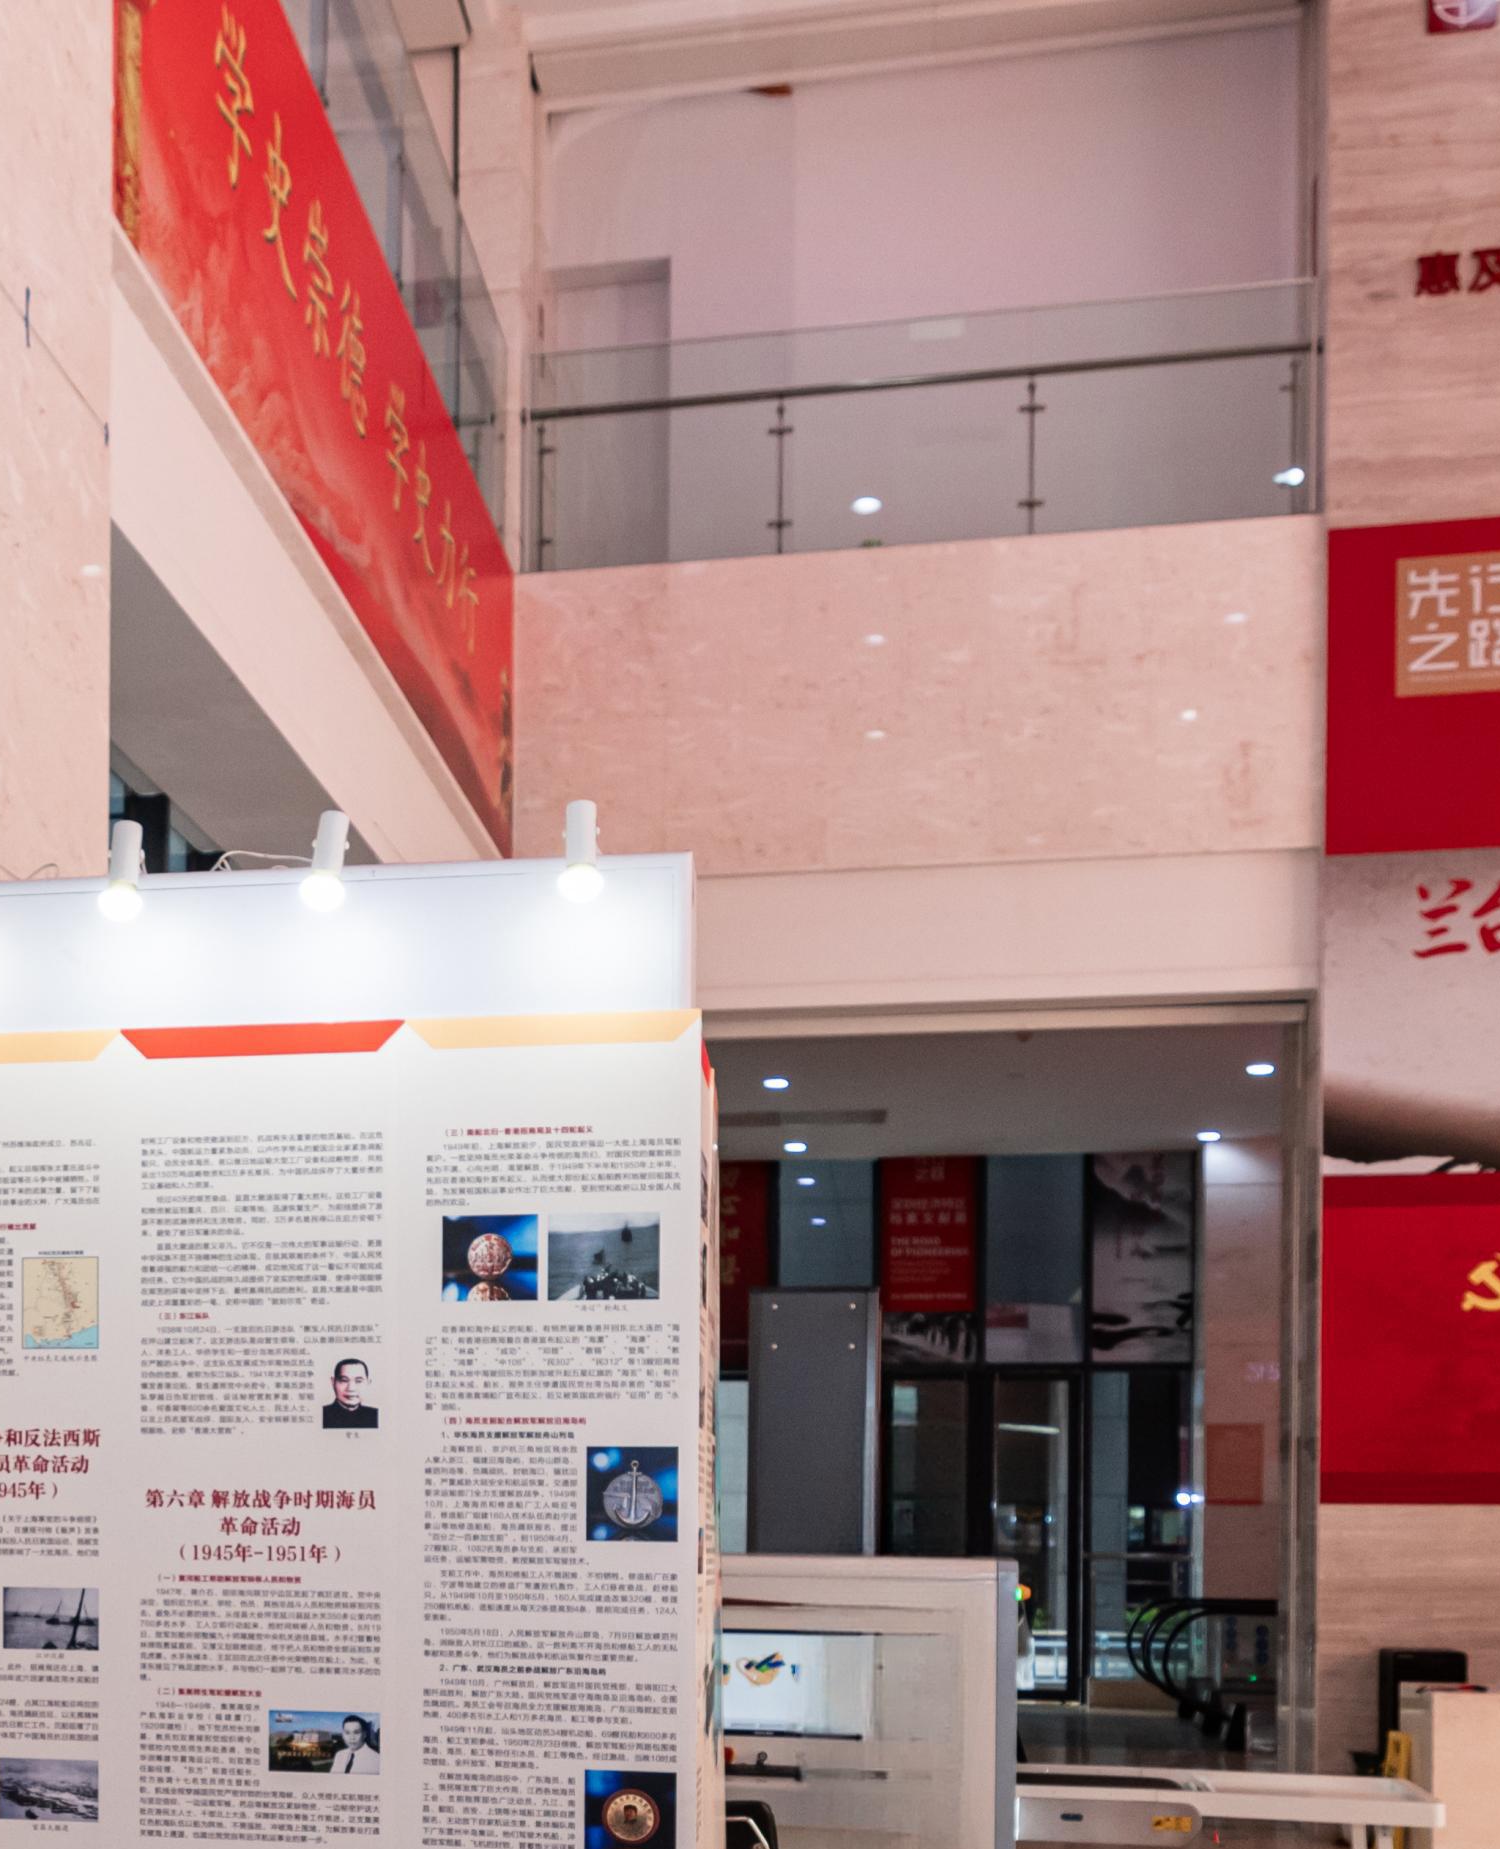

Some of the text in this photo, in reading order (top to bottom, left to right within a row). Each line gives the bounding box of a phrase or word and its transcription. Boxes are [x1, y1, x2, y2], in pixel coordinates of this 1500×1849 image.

[145, 1488, 378, 1510] 第六章 解放战争时期海员
[219, 1517, 302, 1538] 革命活动
